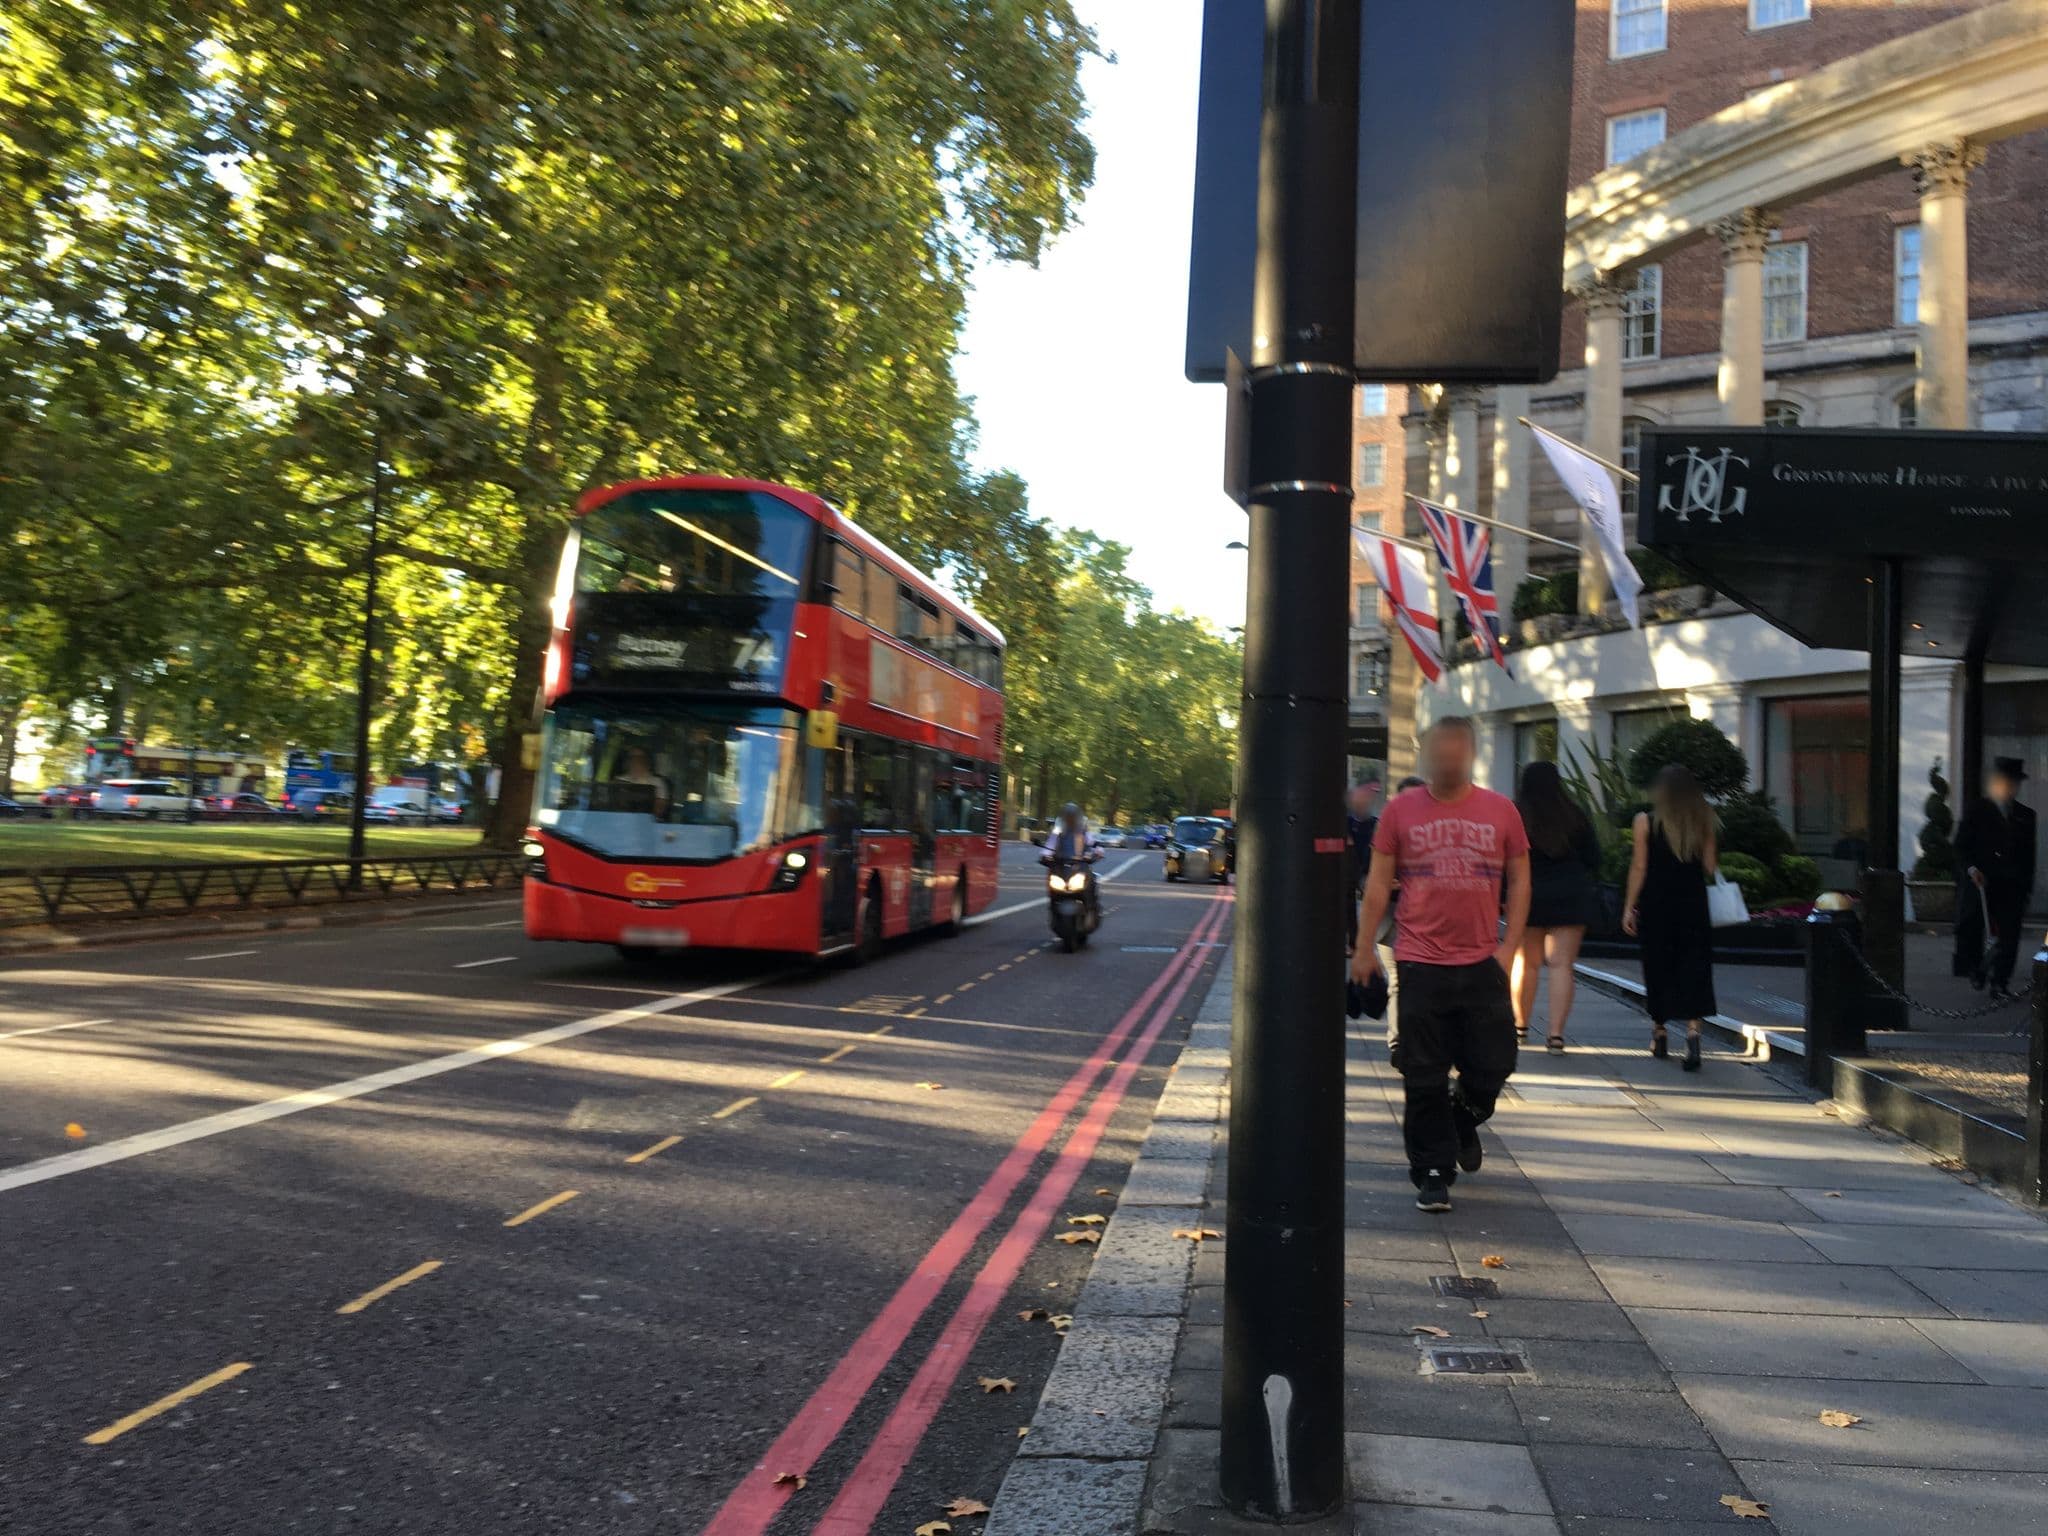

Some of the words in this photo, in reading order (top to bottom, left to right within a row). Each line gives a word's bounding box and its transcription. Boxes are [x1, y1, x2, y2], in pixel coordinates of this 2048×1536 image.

[1895, 466, 1968, 488] HOUSE
[732, 636, 780, 671] 74
[1408, 816, 1497, 853] SUPER
[1433, 857, 1475, 877] DRY
